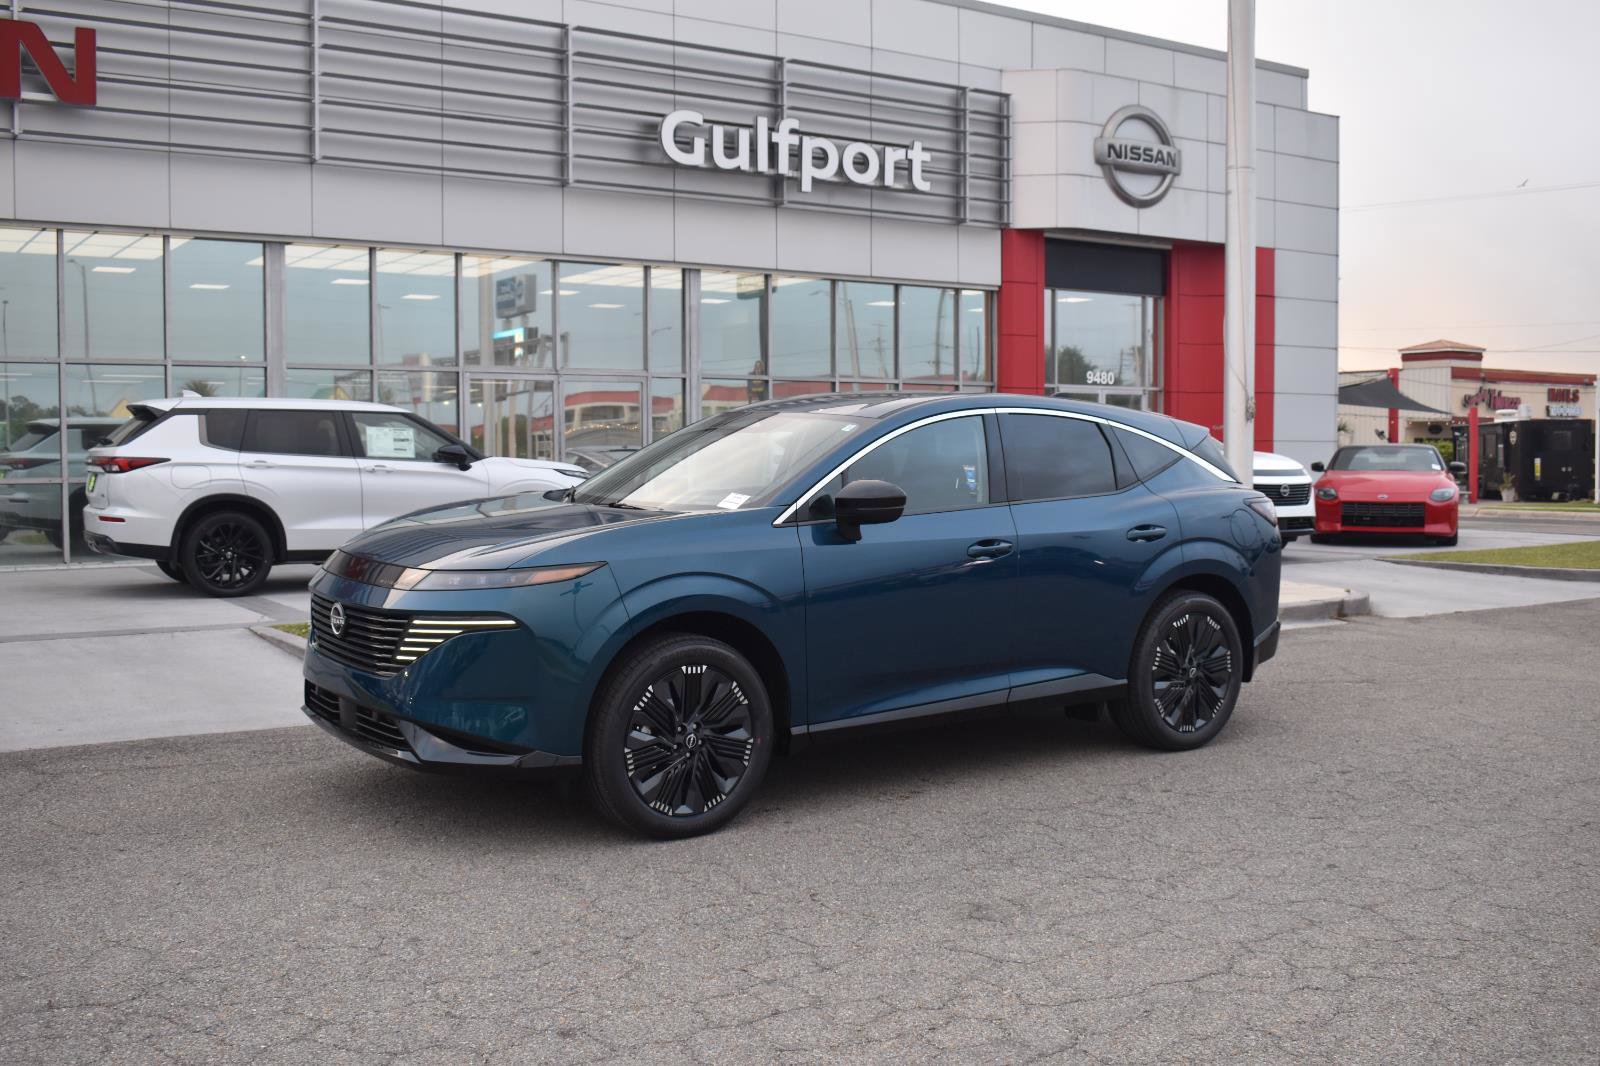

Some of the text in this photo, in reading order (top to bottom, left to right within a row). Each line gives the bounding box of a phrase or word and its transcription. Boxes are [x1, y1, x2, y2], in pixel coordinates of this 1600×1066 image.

[0, 18, 97, 106] N
[660, 110, 932, 192] Gulfport
[1107, 142, 1177, 168] NISSAN
[1086, 370, 1115, 385] 9480
